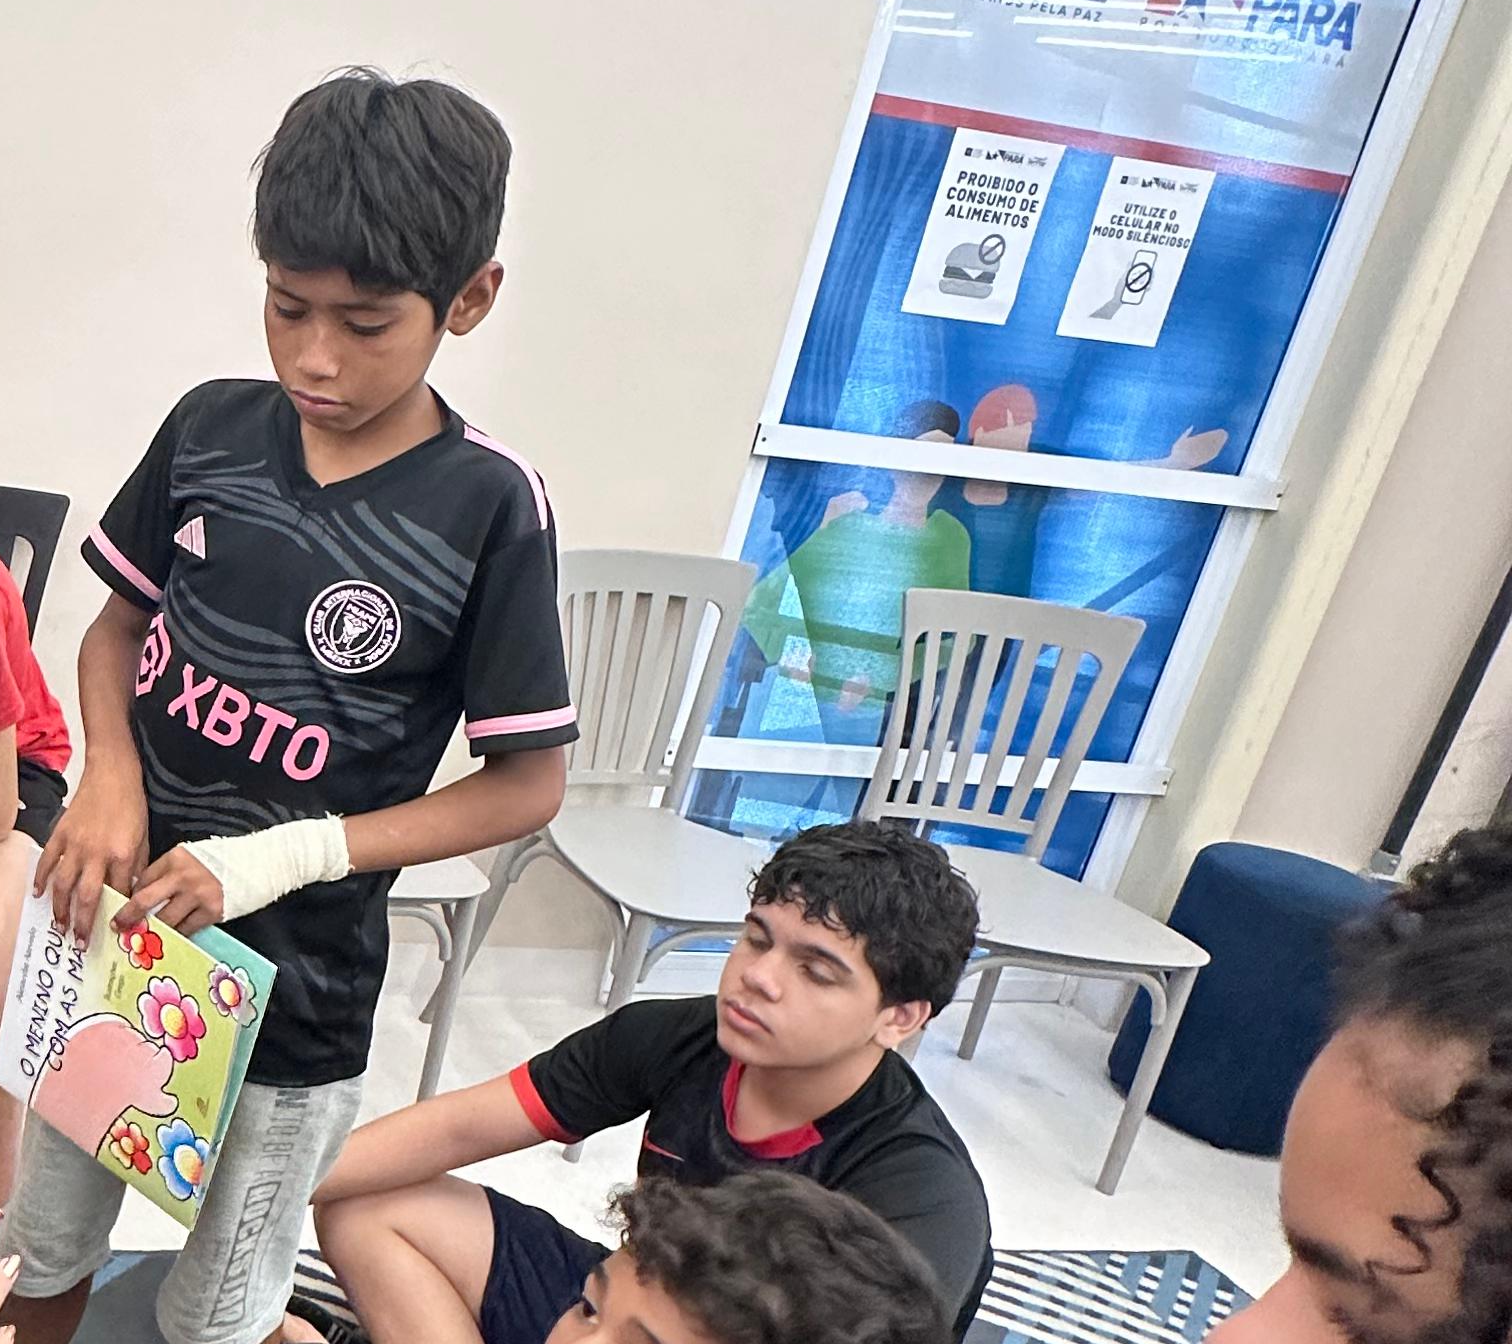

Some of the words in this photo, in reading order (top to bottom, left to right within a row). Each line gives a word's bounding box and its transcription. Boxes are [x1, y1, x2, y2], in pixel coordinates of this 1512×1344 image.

[1029, 1, 1067, 18] PELA
[1072, 8, 1103, 23] PAZ
[957, 170, 1026, 194] PROIBIDO
[1028, 183, 1039, 196] O
[946, 186, 1017, 210] CONSUMO
[1019, 198, 1040, 213] DE
[1123, 202, 1168, 220] UTILIZE
[1169, 209, 1178, 221] O
[945, 203, 1030, 229] ALIMENTOS
[1110, 214, 1162, 232] CELULAR
[1164, 222, 1180, 234] NO
[1093, 225, 1124, 239] MODO
[167, 662, 330, 781] XBTO
[25, 969, 55, 1058] MENINO
[47, 1017, 71, 1072] COM
[60, 984, 78, 1018] AS
[20, 1057, 35, 1077] O
